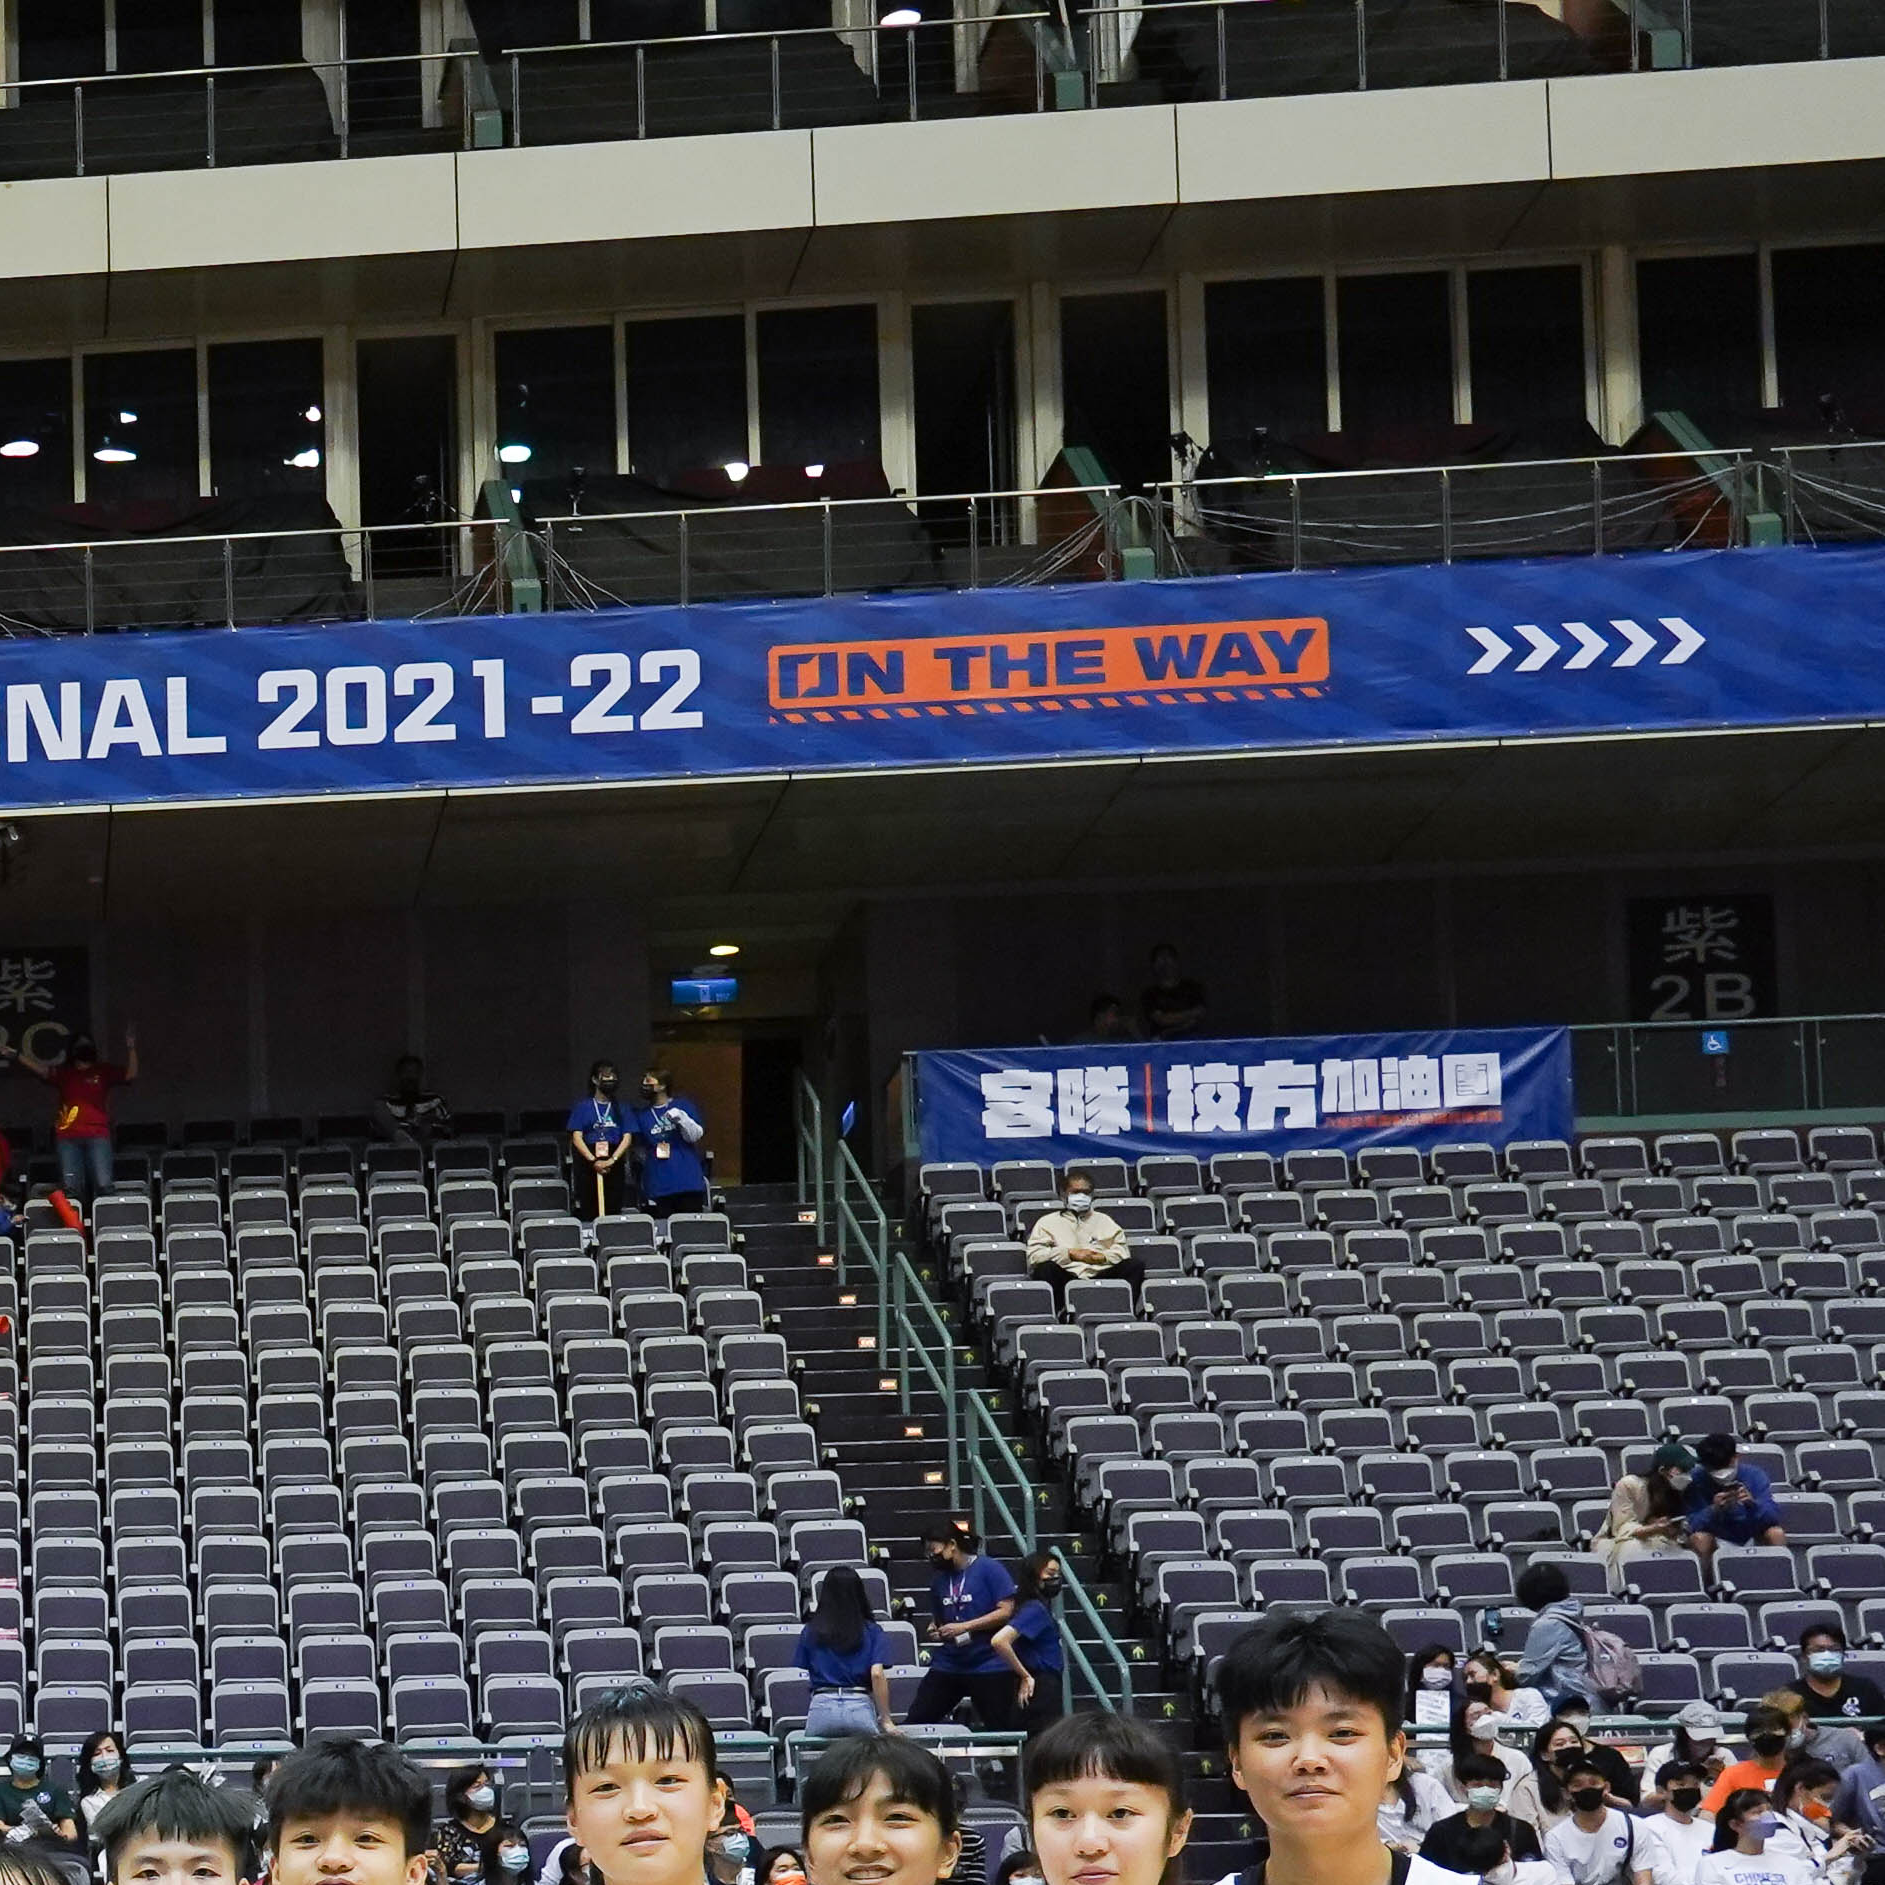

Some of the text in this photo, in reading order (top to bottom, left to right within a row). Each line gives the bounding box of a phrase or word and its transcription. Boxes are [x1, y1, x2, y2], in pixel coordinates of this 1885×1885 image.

[777, 626, 1319, 700] ON THE WAY
[256, 648, 704, 750] 2021-22
[1661, 910, 1739, 964] 紫
[1649, 974, 1755, 1020] 2B
